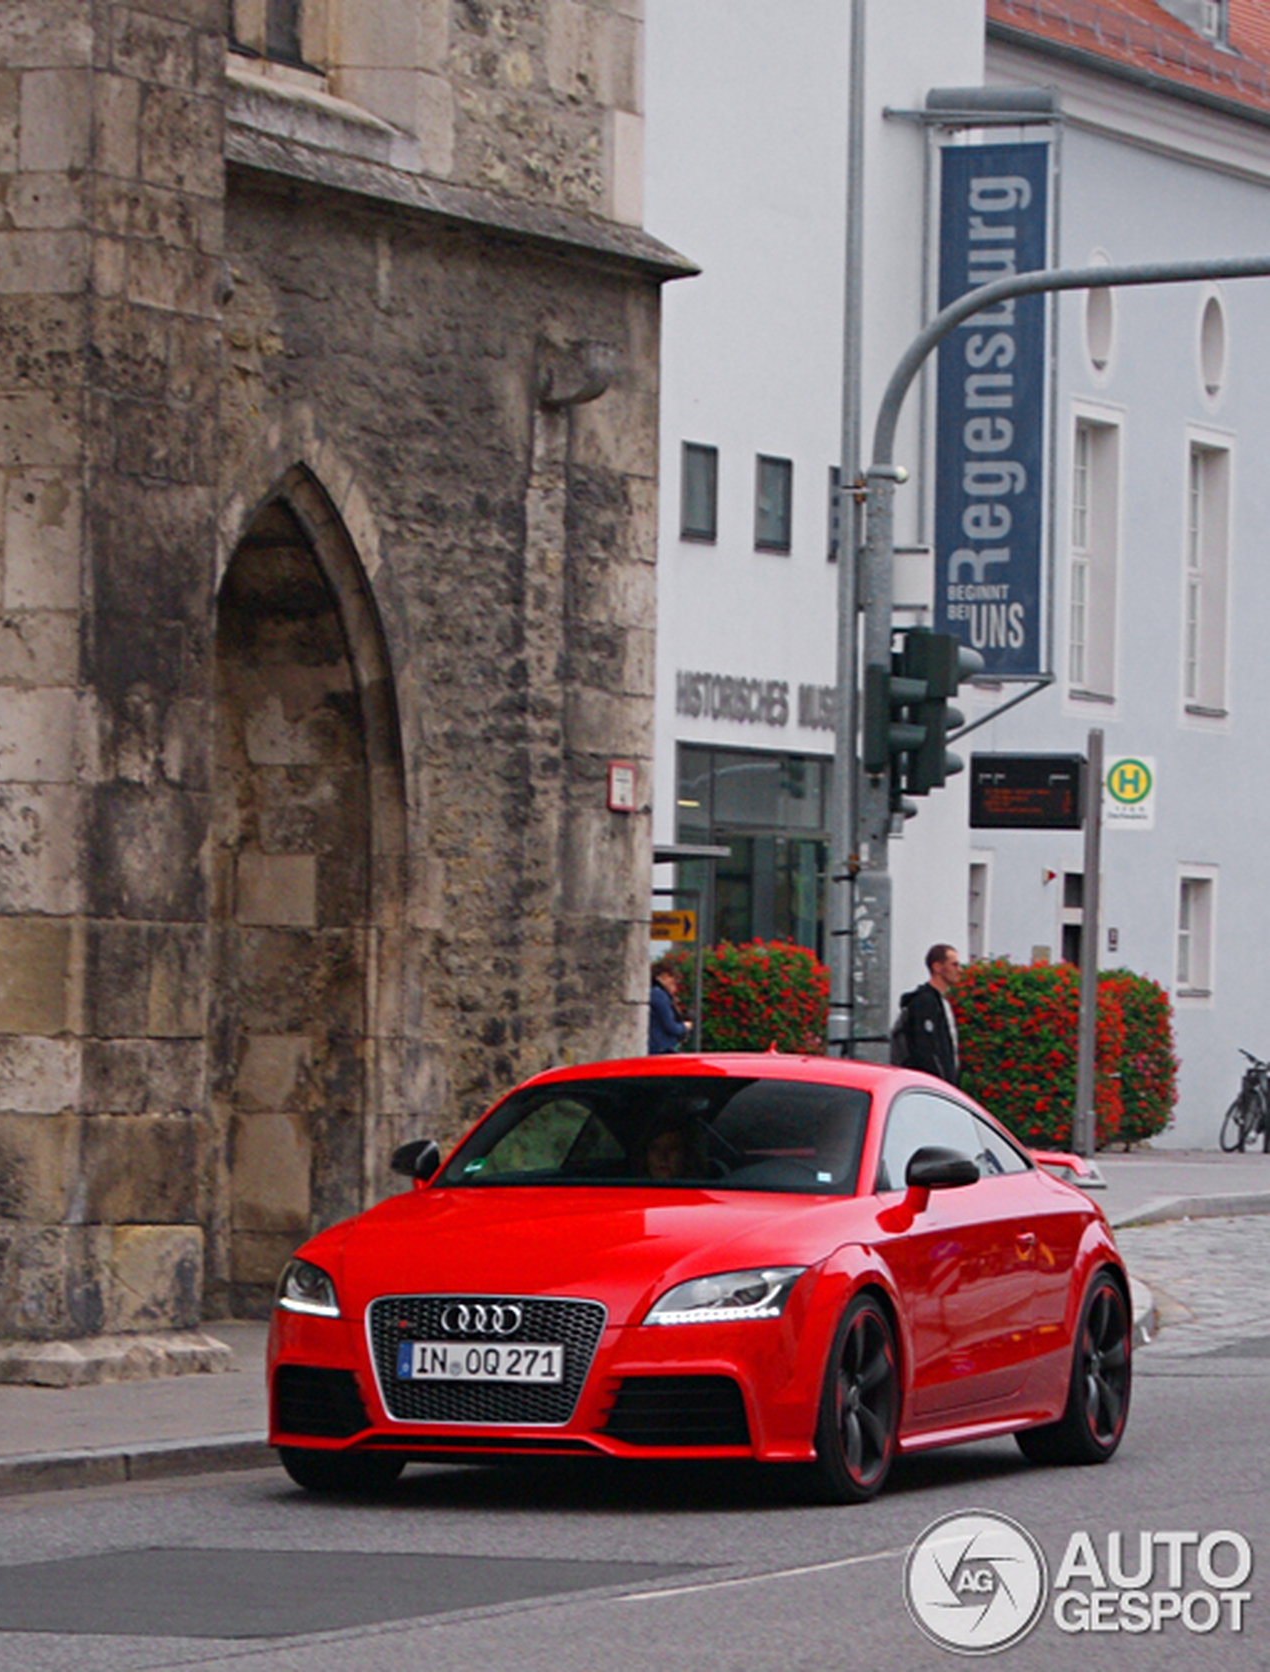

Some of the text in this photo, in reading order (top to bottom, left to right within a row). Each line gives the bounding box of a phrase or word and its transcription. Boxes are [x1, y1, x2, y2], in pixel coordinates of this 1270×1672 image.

[947, 175, 1032, 583] Regensburg
[947, 584, 1010, 600] BEGINNT
[947, 602, 1025, 649] BEI UNS
[676, 669, 790, 728] HISTORISCHES
[1118, 769, 1140, 793] H
[416, 1347, 448, 1374] IN
[506, 1349, 556, 1377] 271
